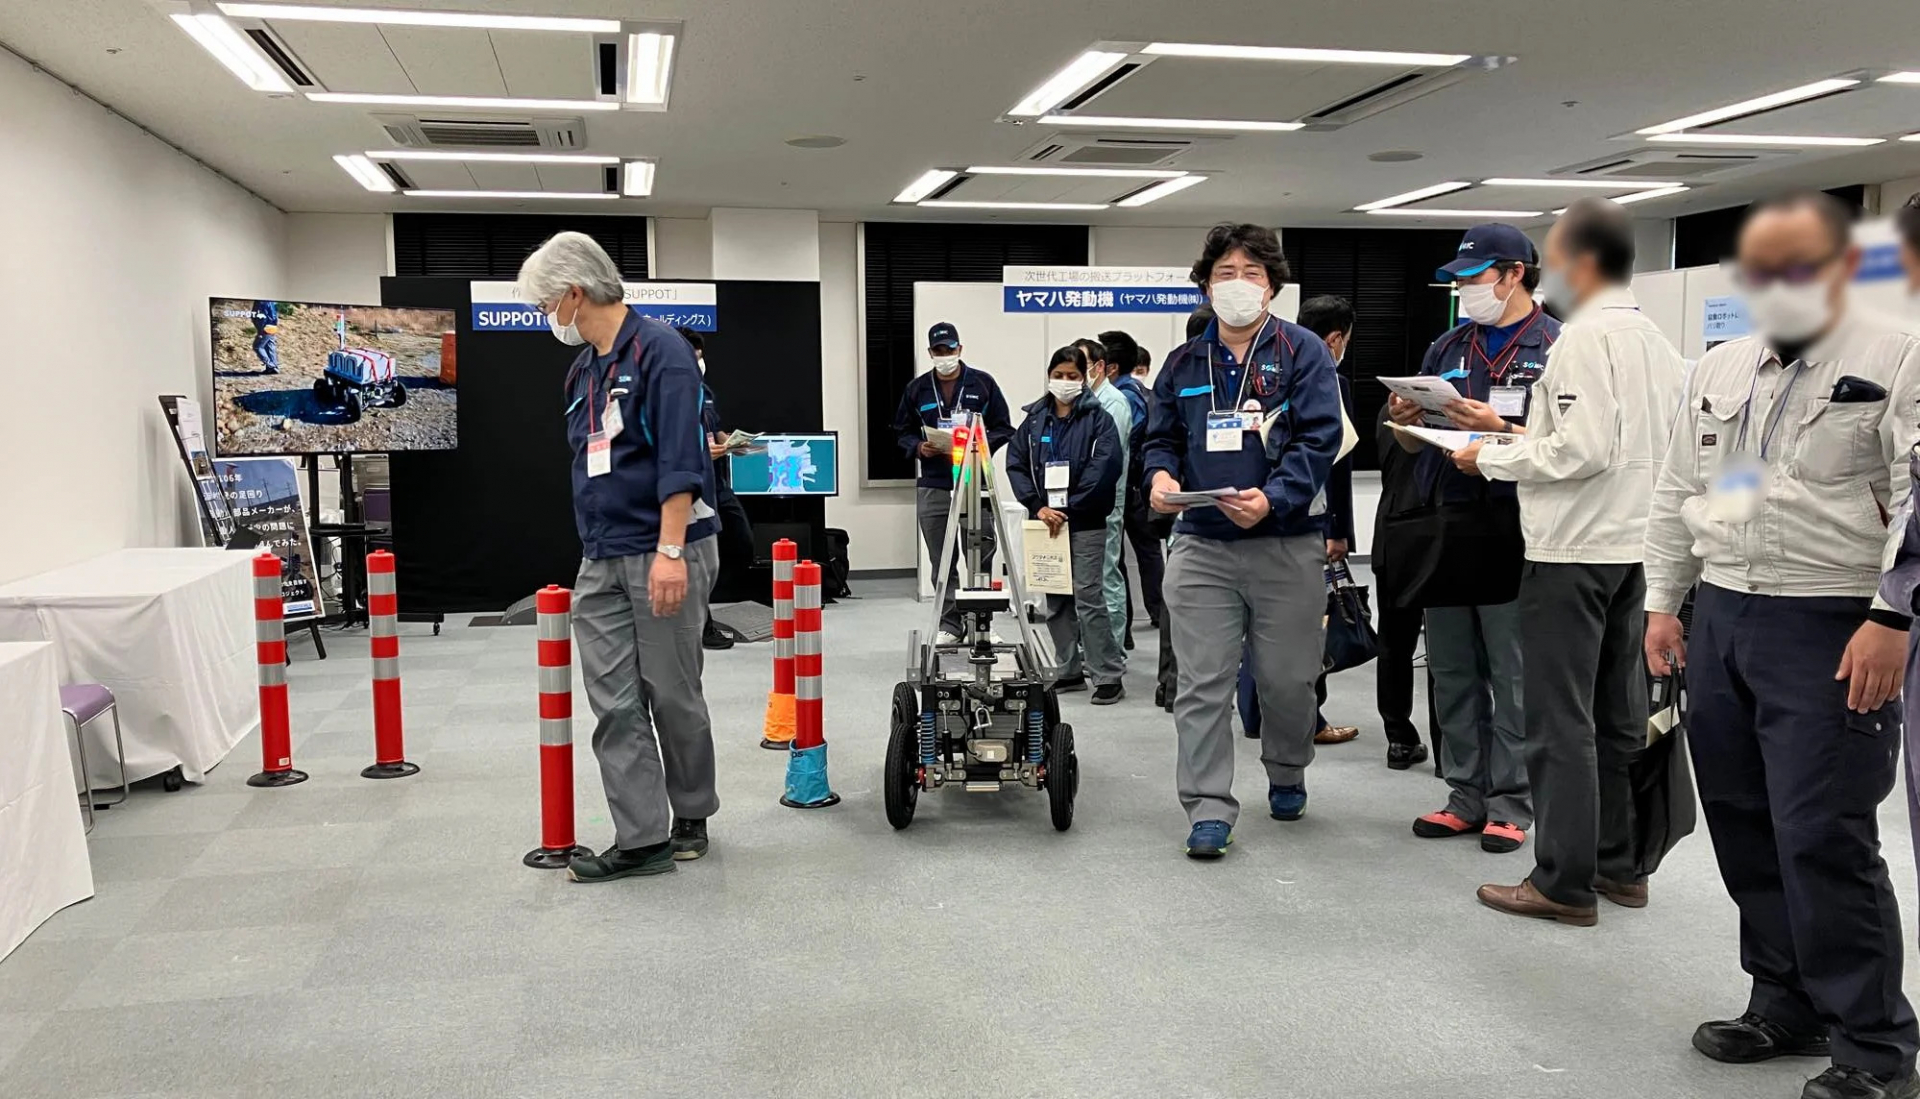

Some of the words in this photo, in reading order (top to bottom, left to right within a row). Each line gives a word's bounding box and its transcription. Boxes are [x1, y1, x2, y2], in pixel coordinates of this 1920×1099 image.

[1024, 271, 1191, 283] 次世代工場の搬送プラットフォー
[1016, 290, 1114, 308] ヤマハ発動機
[223, 310, 257, 318] SUPPOT
